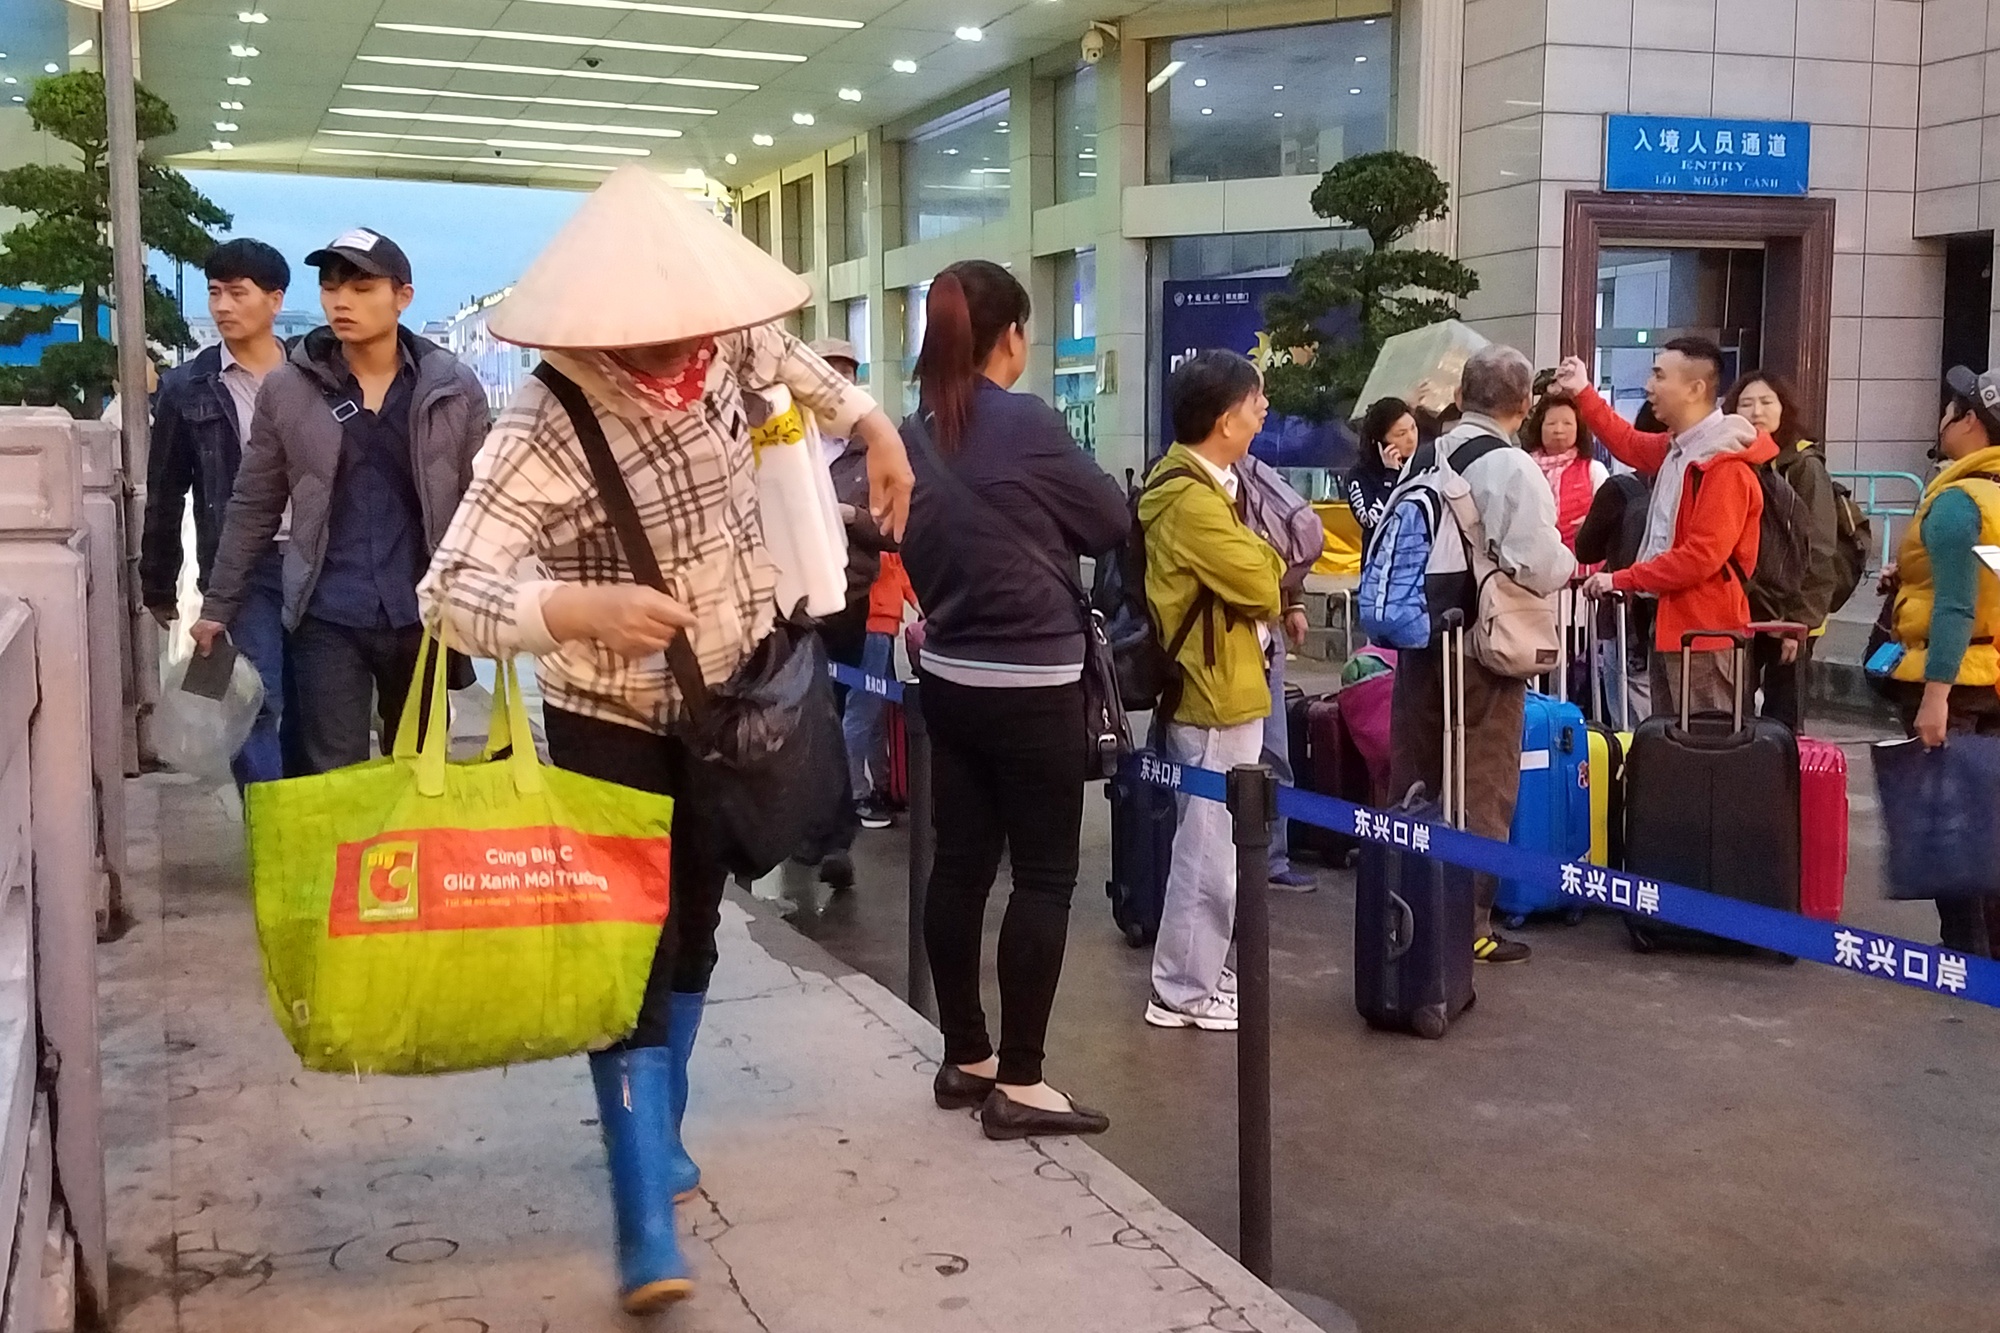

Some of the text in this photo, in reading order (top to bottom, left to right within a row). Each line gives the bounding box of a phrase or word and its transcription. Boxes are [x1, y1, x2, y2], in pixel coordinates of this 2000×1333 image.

[1633, 127, 1787, 158] 入境人员通道
[1681, 159, 1747, 173] ENTRY
[1140, 756, 1182, 789] 东兴口岸
[1354, 808, 1431, 853] 东兴口岸
[530, 847, 557, 865] Big
[560, 845, 573, 862] C
[480, 873, 520, 890] Xanh
[1560, 862, 1661, 916] 东兴口岸
[1833, 930, 1968, 993] 东兴口岸
